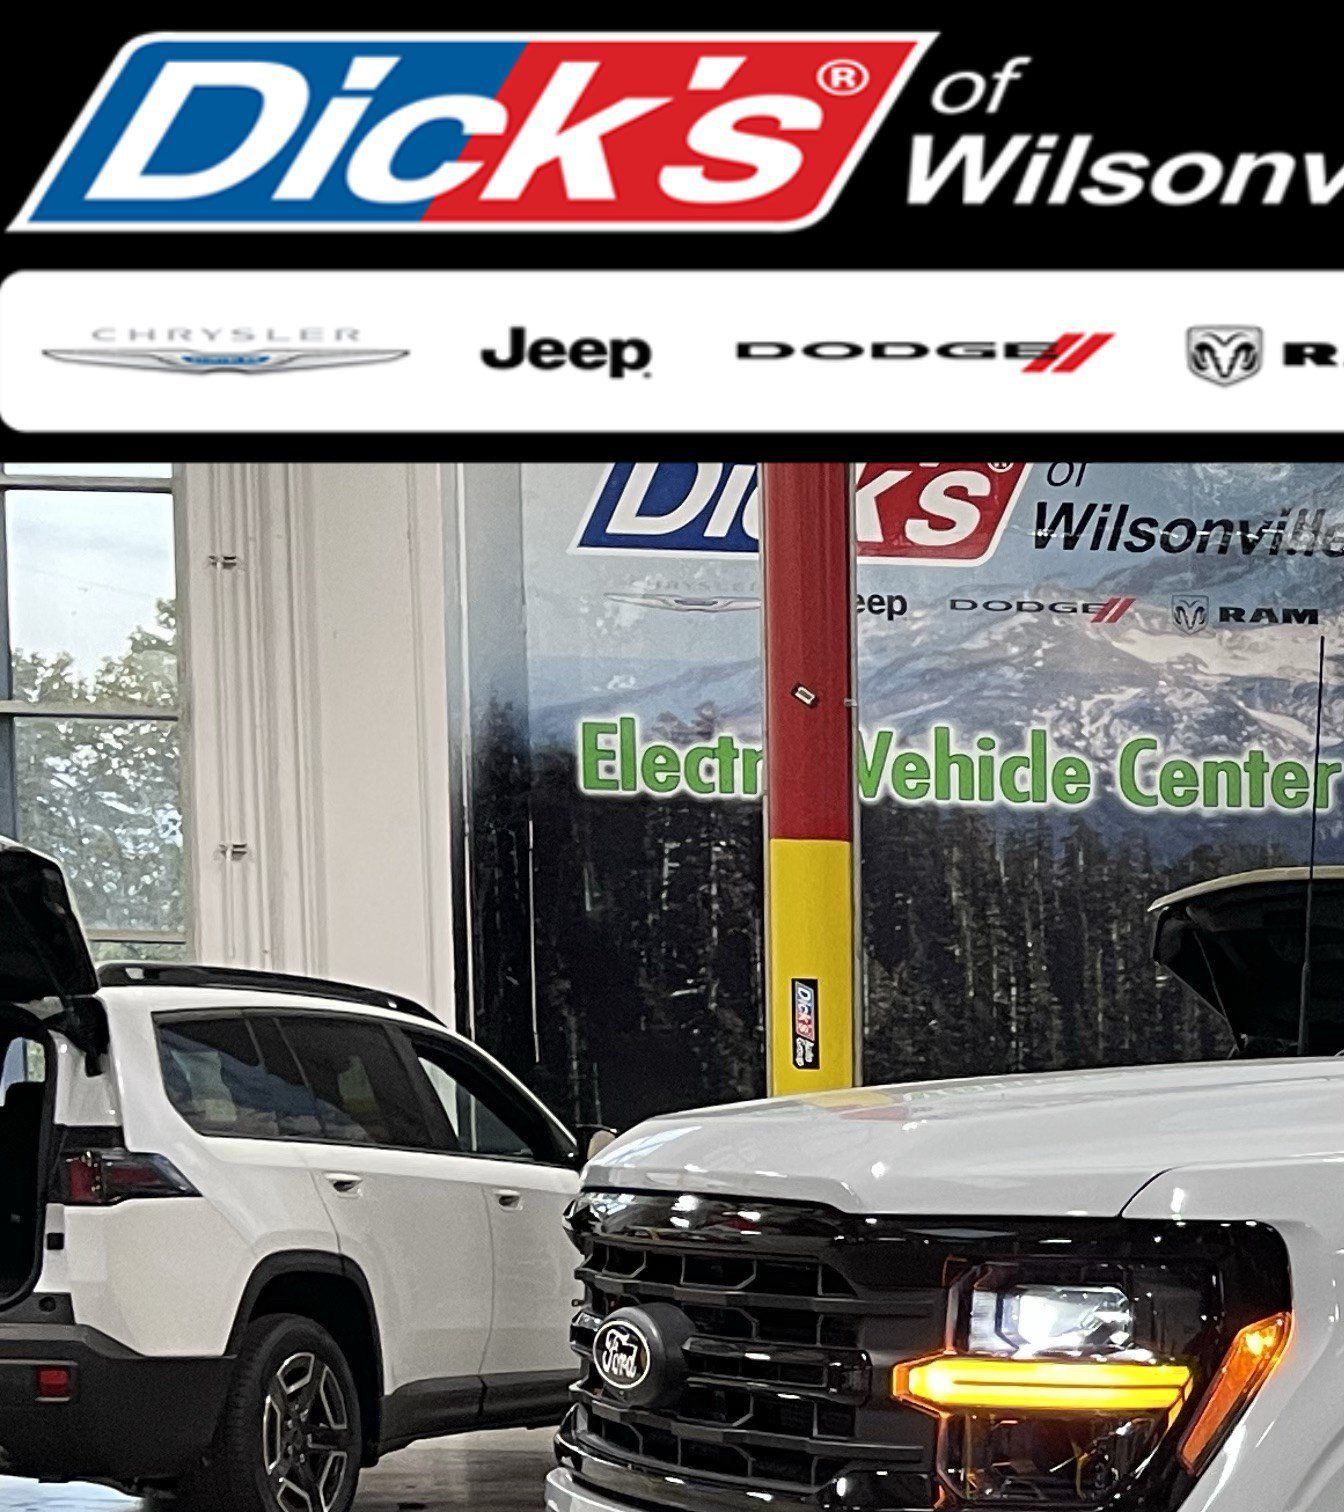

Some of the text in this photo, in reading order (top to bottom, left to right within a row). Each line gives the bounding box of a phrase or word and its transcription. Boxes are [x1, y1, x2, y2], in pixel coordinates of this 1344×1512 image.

[950, 598, 1106, 613] DODGE
[1219, 606, 1319, 624] RAM
[582, 717, 1342, 809] Electr Vehicle Center
[602, 1328, 638, 1378] Ford
